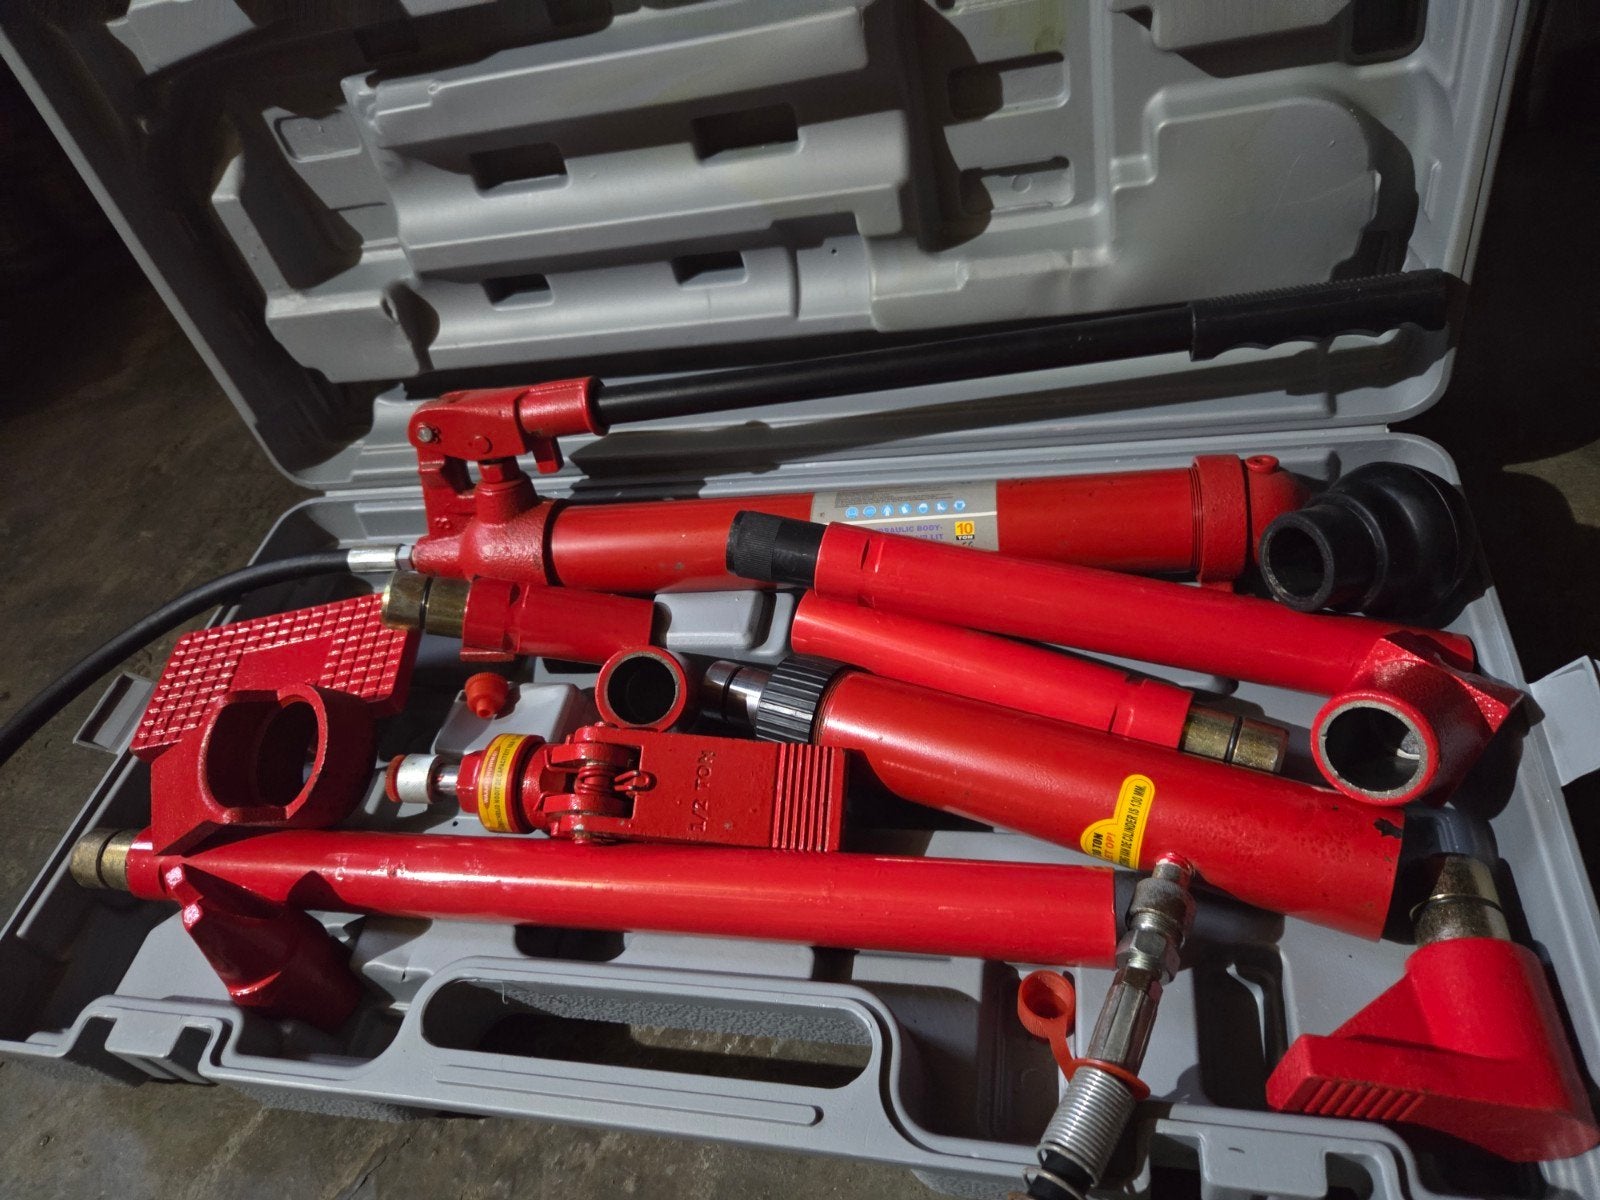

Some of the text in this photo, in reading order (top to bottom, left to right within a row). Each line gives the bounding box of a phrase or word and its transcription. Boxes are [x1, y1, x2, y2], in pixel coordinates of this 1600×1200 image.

[956, 523, 974, 535] 10
[690, 750, 717, 832] 1/2 TON
[1130, 796, 1144, 808] 130
[1128, 807, 1140, 816] IS
[1122, 815, 1138, 842] CILINDER
[1092, 832, 1104, 849] TON
[1106, 831, 1116, 849] OP!
